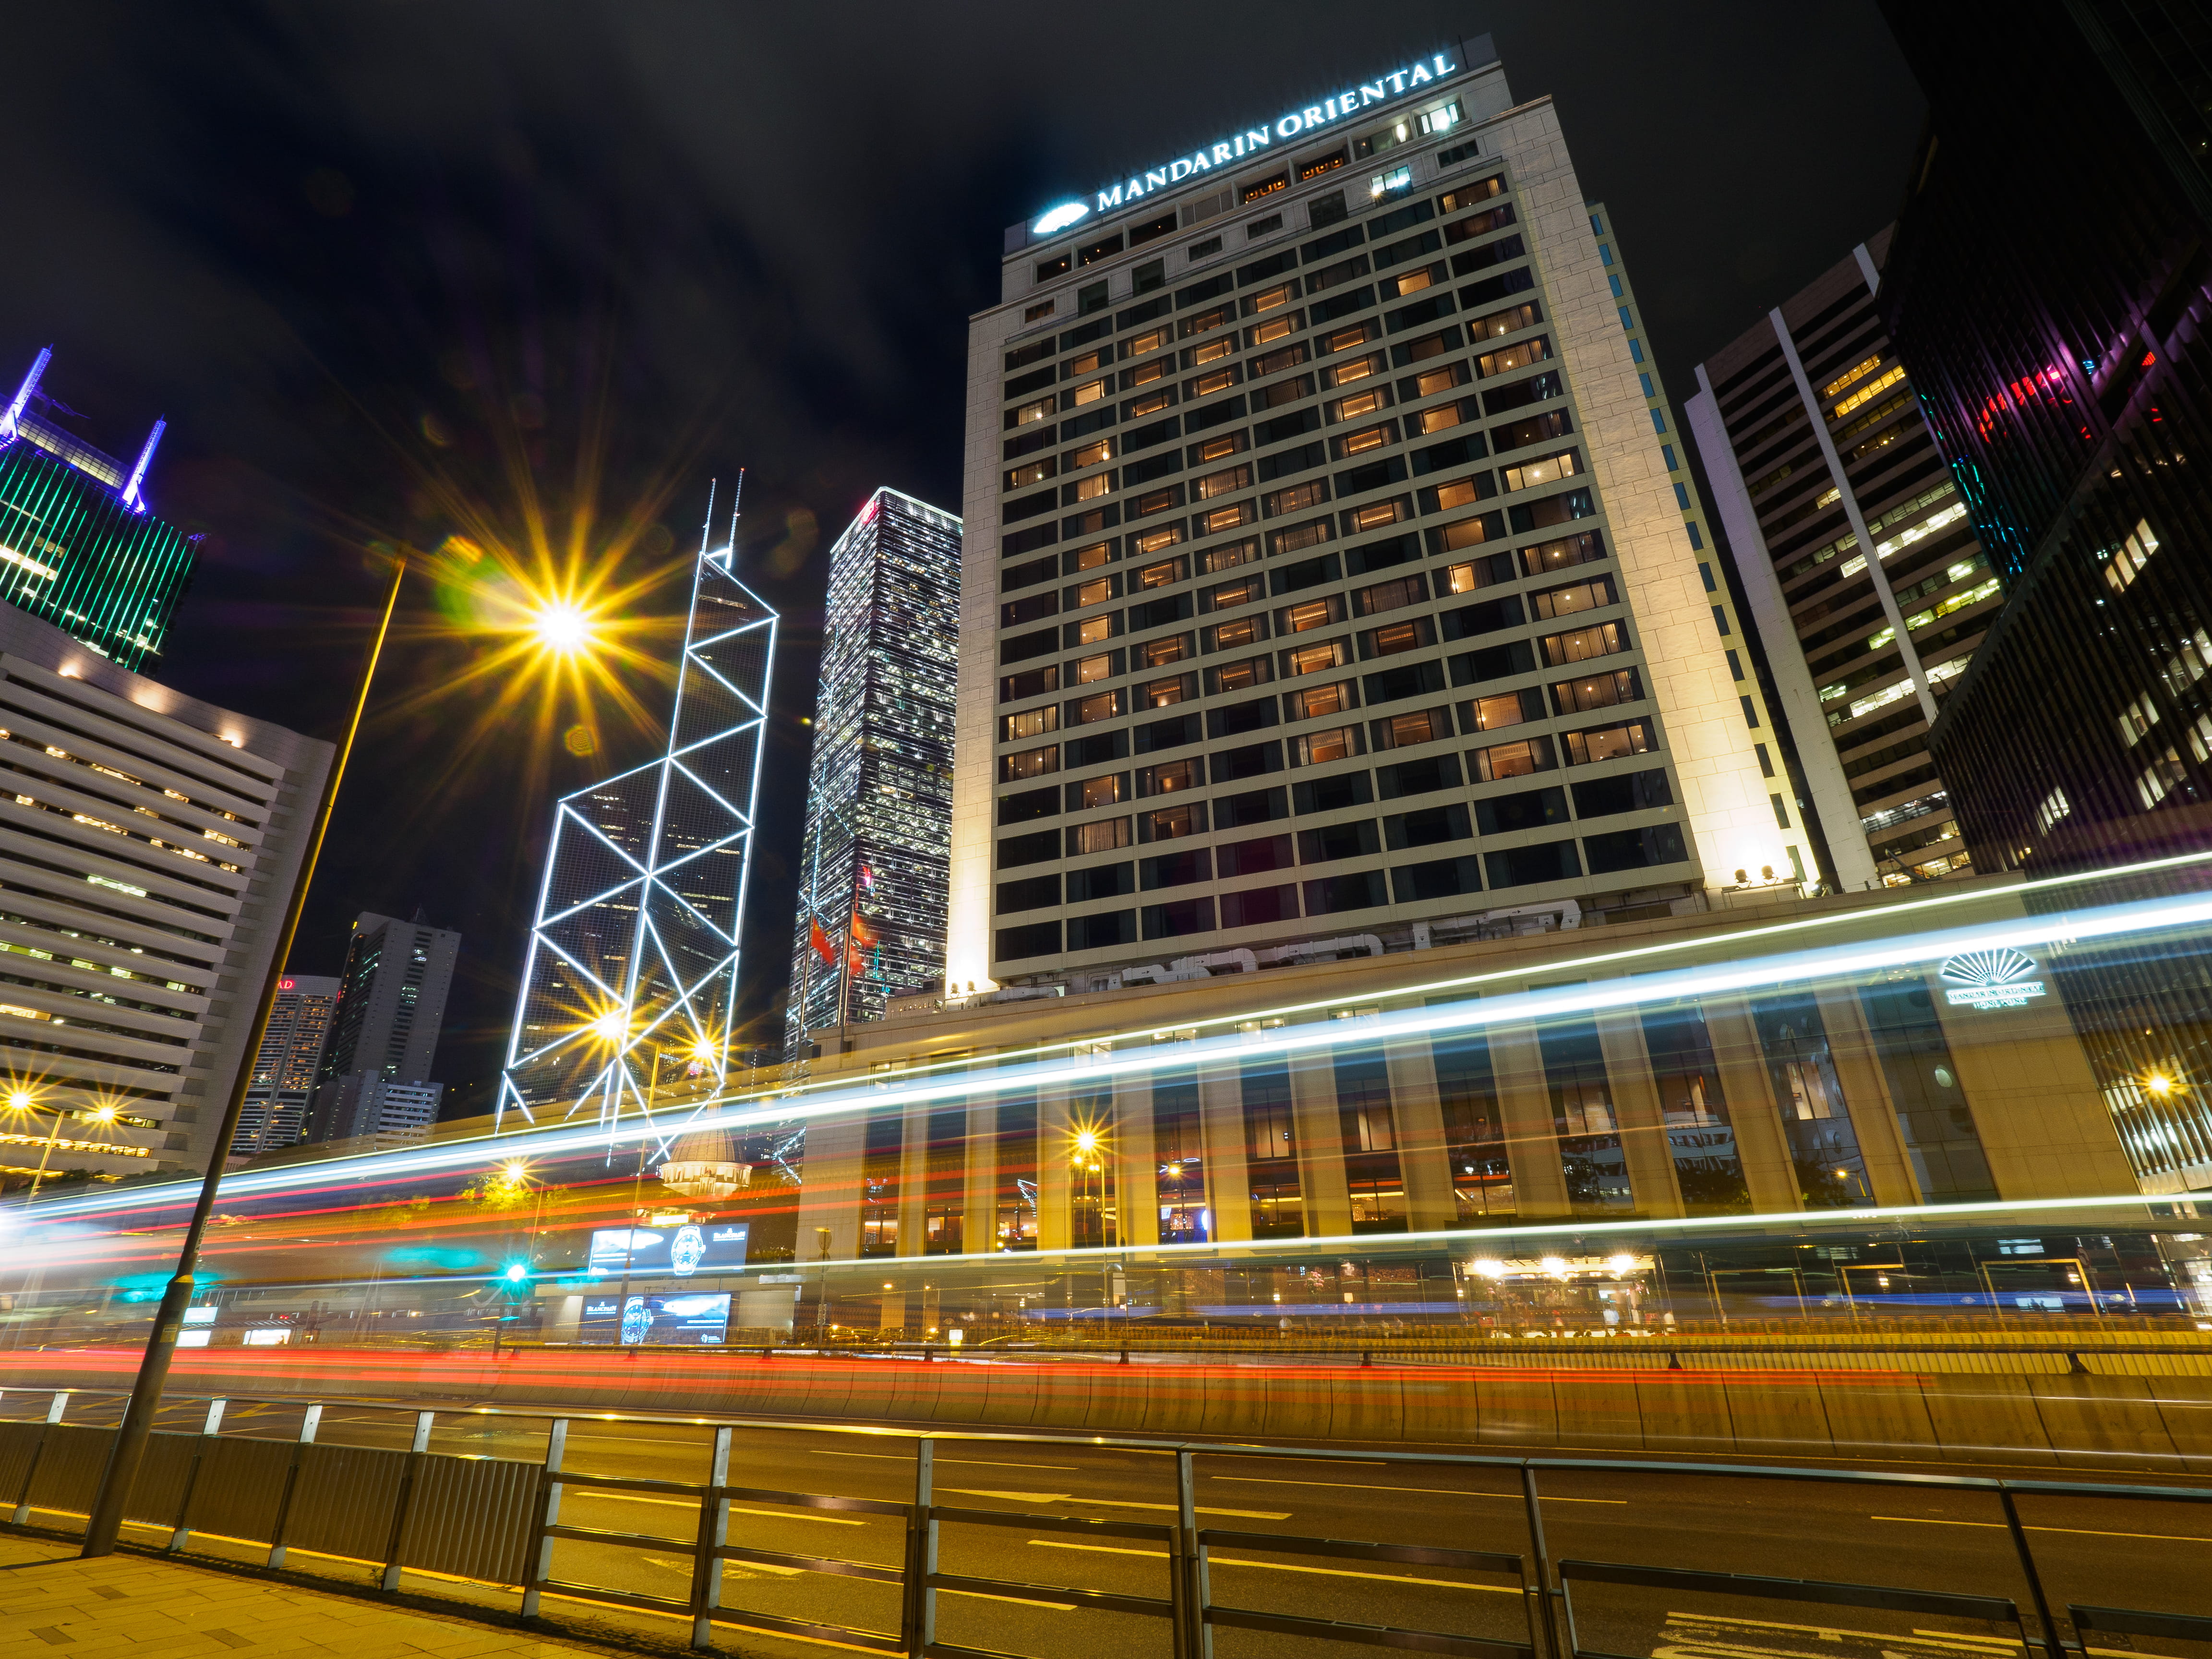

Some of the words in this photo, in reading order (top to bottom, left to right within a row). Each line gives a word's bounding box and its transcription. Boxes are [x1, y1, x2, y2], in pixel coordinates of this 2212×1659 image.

[1097, 125, 1270, 212] MANDARIN
[1277, 55, 1456, 137] ORIENTAL
[1974, 999, 2000, 1009] HONG
[2001, 997, 2027, 1007] KONG
